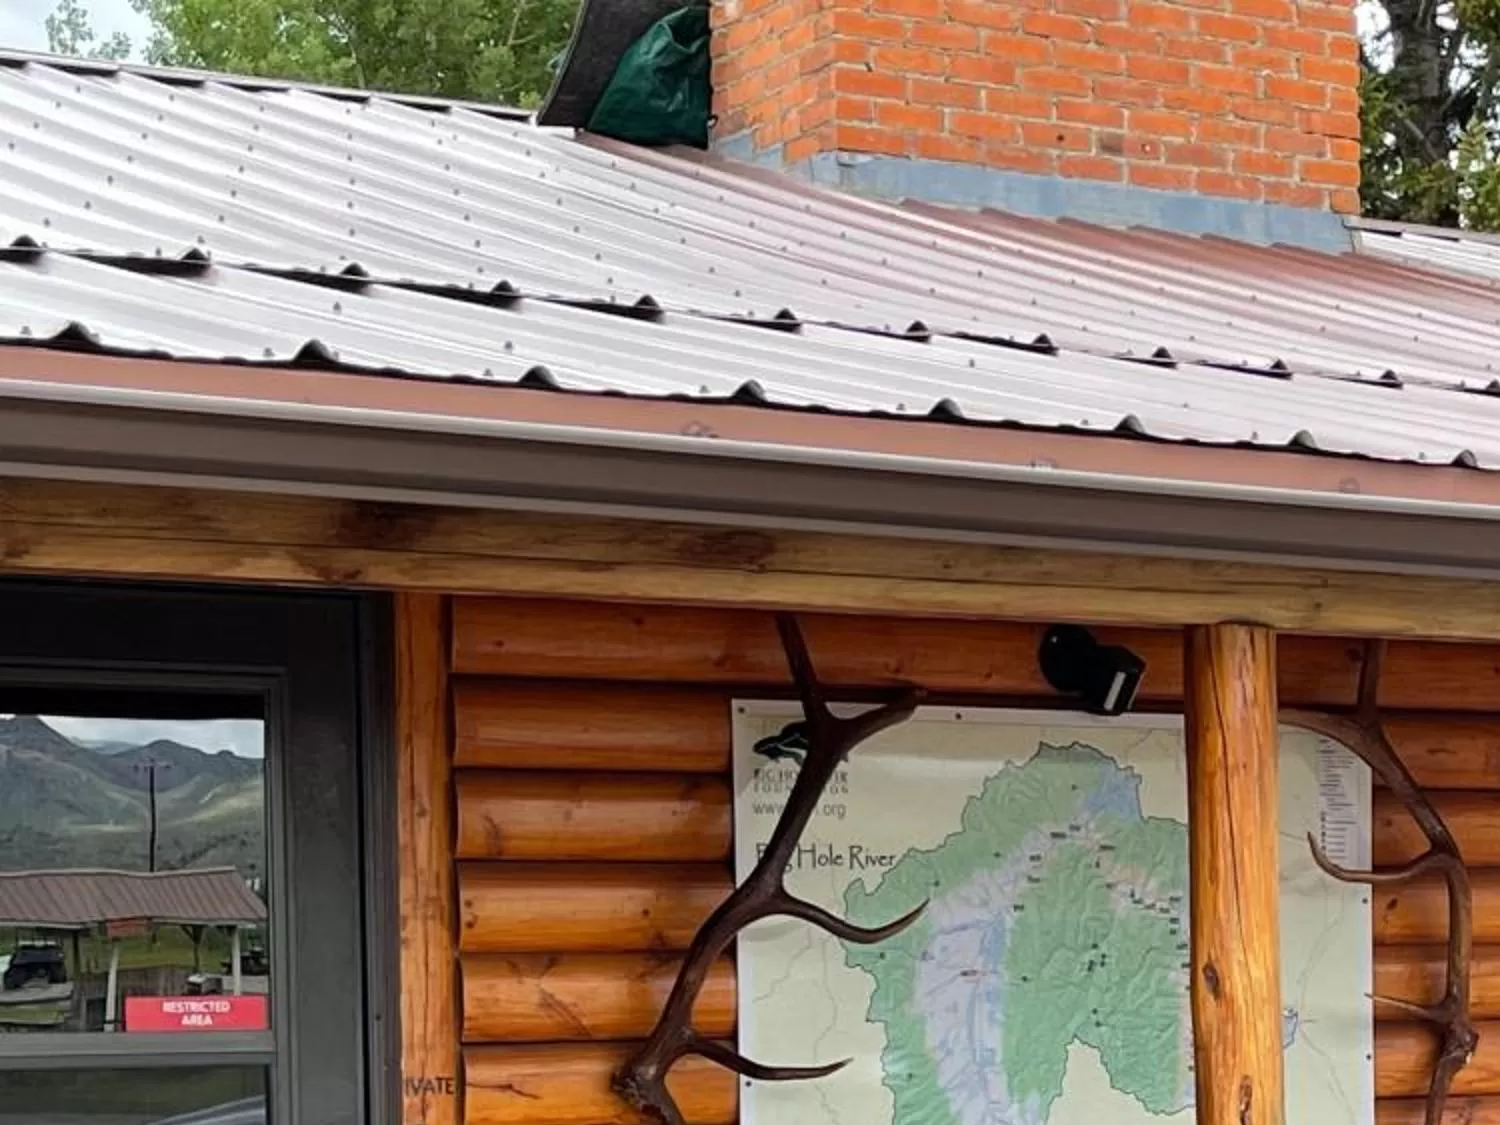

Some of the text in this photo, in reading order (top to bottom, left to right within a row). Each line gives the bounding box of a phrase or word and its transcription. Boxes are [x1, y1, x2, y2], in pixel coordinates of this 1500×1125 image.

[796, 842, 844, 869] Hole
[848, 844, 897, 870] River
[162, 1001, 231, 1013] RESTRICTED
[181, 1014, 213, 1025] AREA
